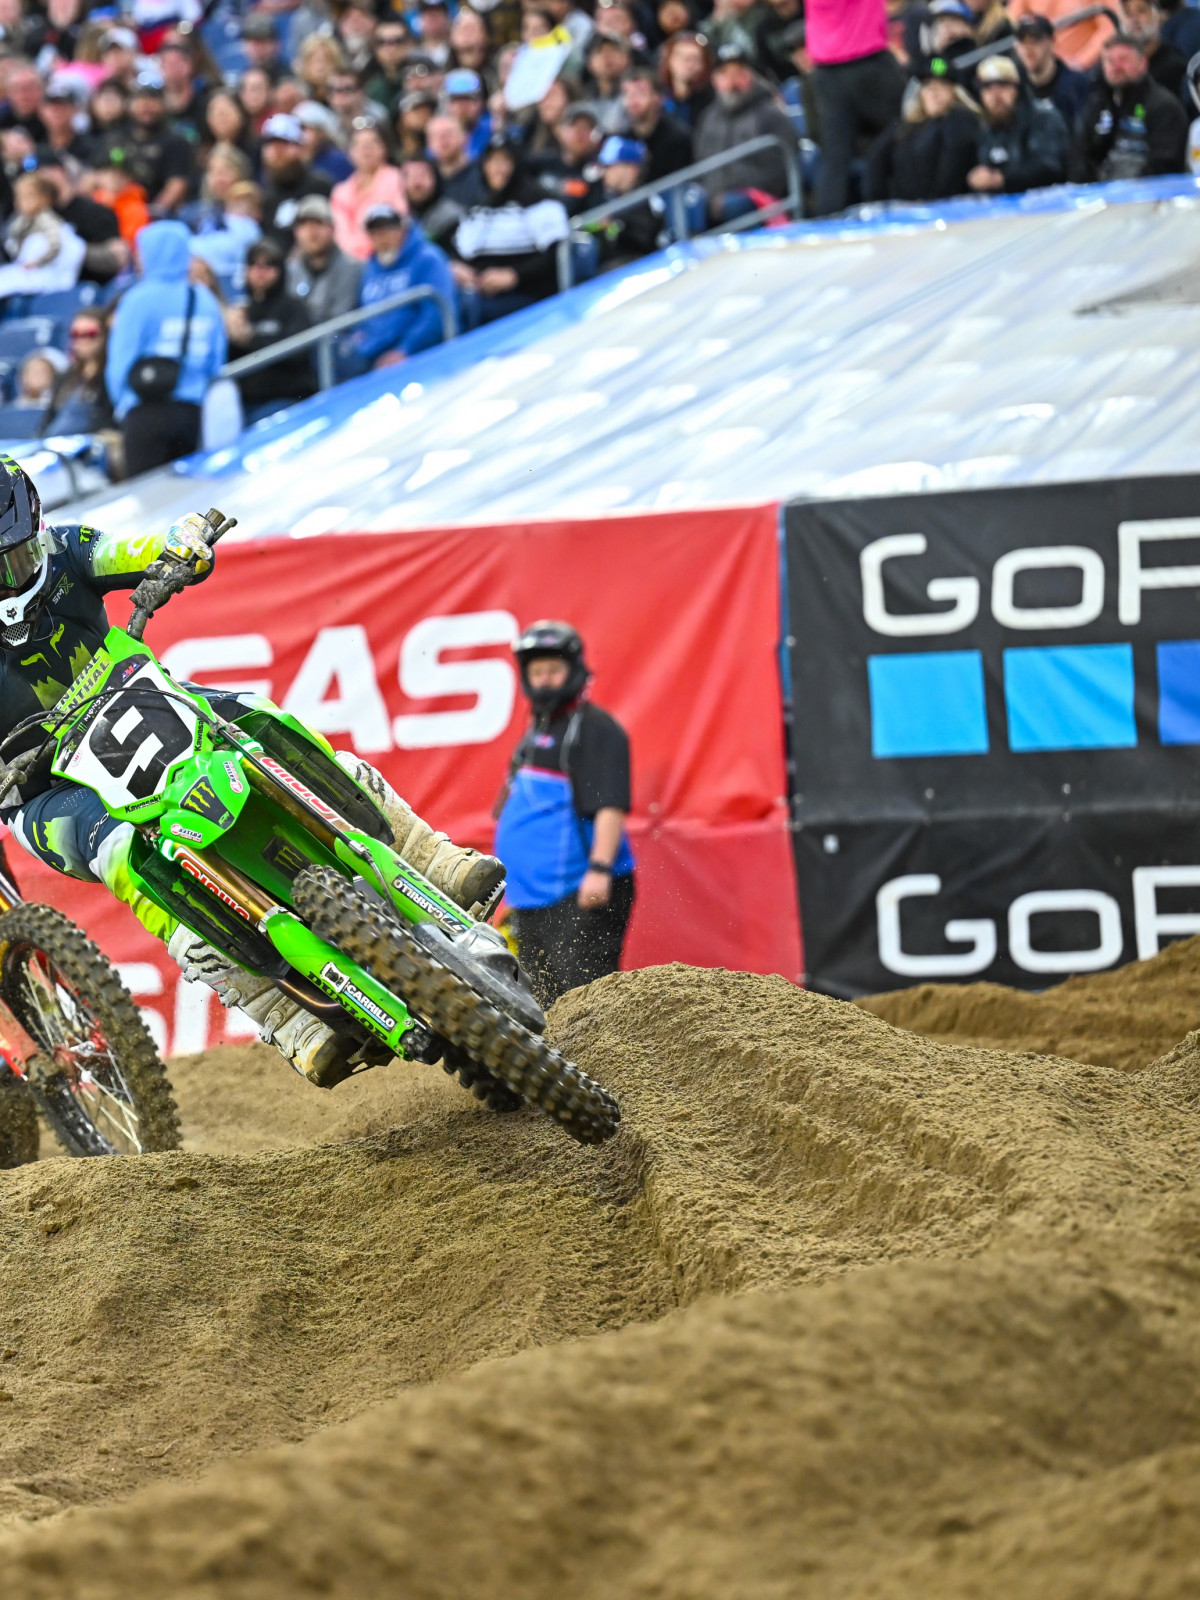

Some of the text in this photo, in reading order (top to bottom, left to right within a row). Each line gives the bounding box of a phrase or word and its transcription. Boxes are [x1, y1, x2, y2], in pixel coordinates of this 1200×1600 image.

[84, 685, 115, 722] MONSTR
[89, 677, 193, 800] 9
[194, 716, 205, 752] Kawasa
[393, 879, 444, 919] CARRILLO
[307, 970, 389, 1041] DUNLOP
[346, 983, 396, 1029] CARRILLO
